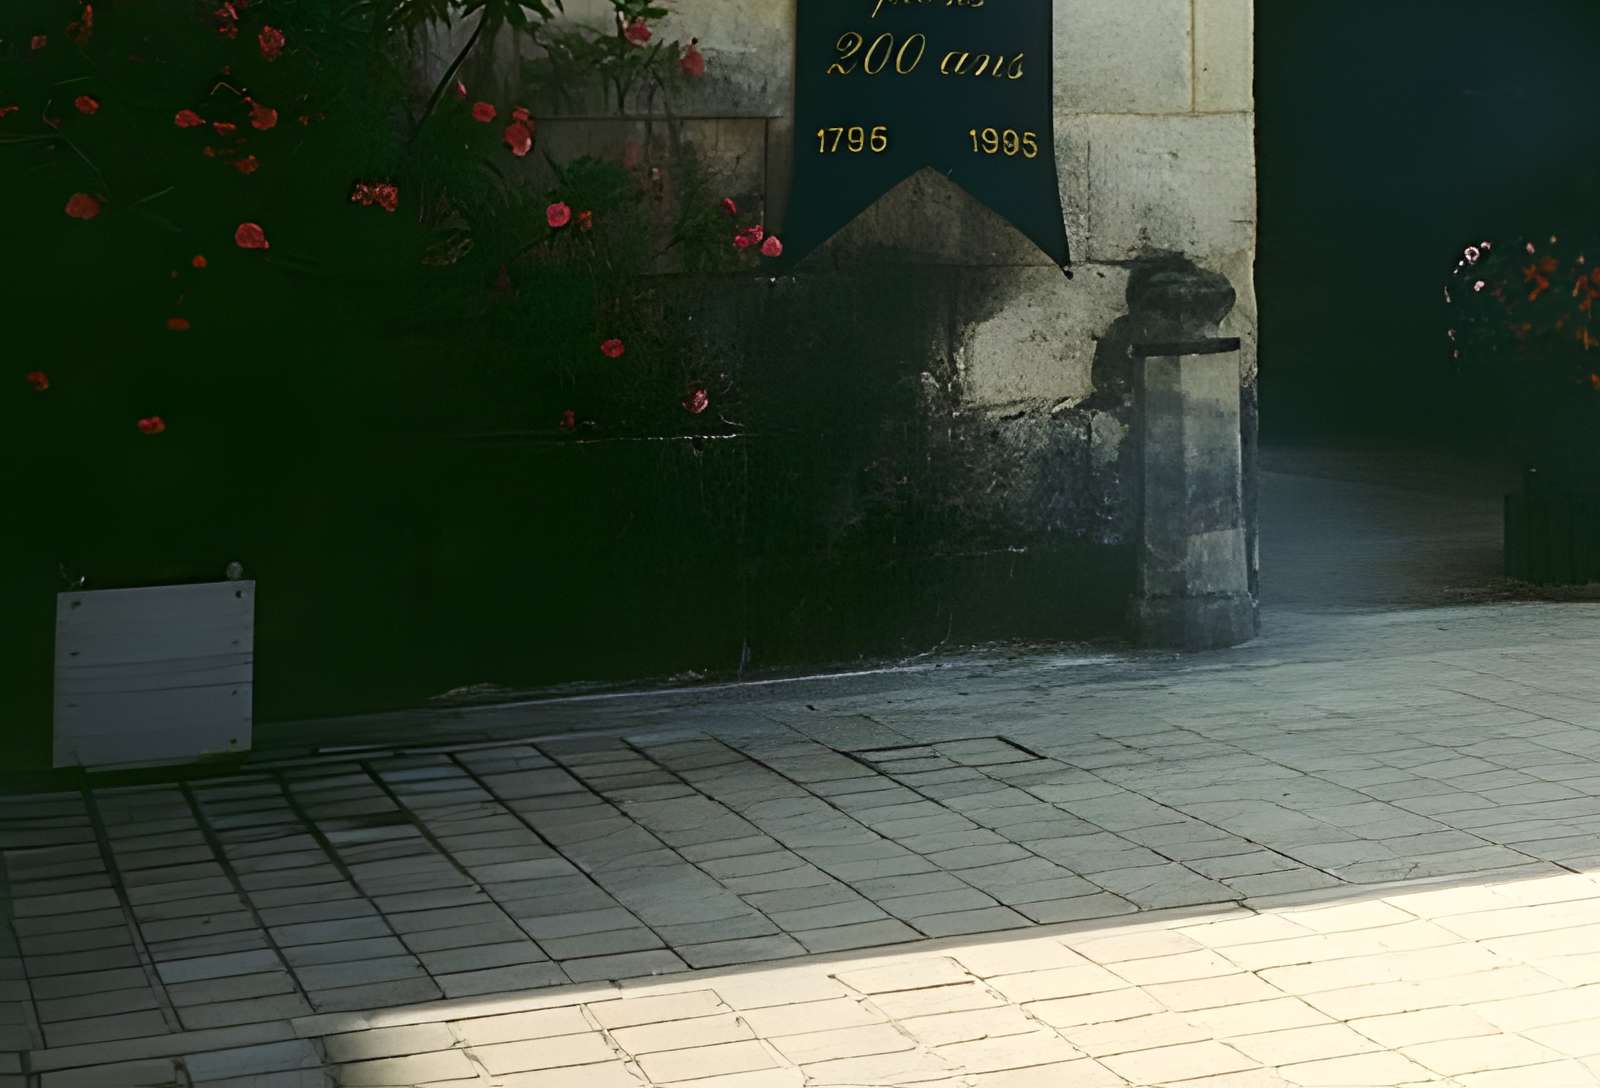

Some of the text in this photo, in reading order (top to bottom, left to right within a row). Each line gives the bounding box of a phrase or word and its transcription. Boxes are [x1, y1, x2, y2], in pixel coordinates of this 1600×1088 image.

[826, 31, 1025, 80] 200 ans
[968, 127, 1039, 158] 1995
